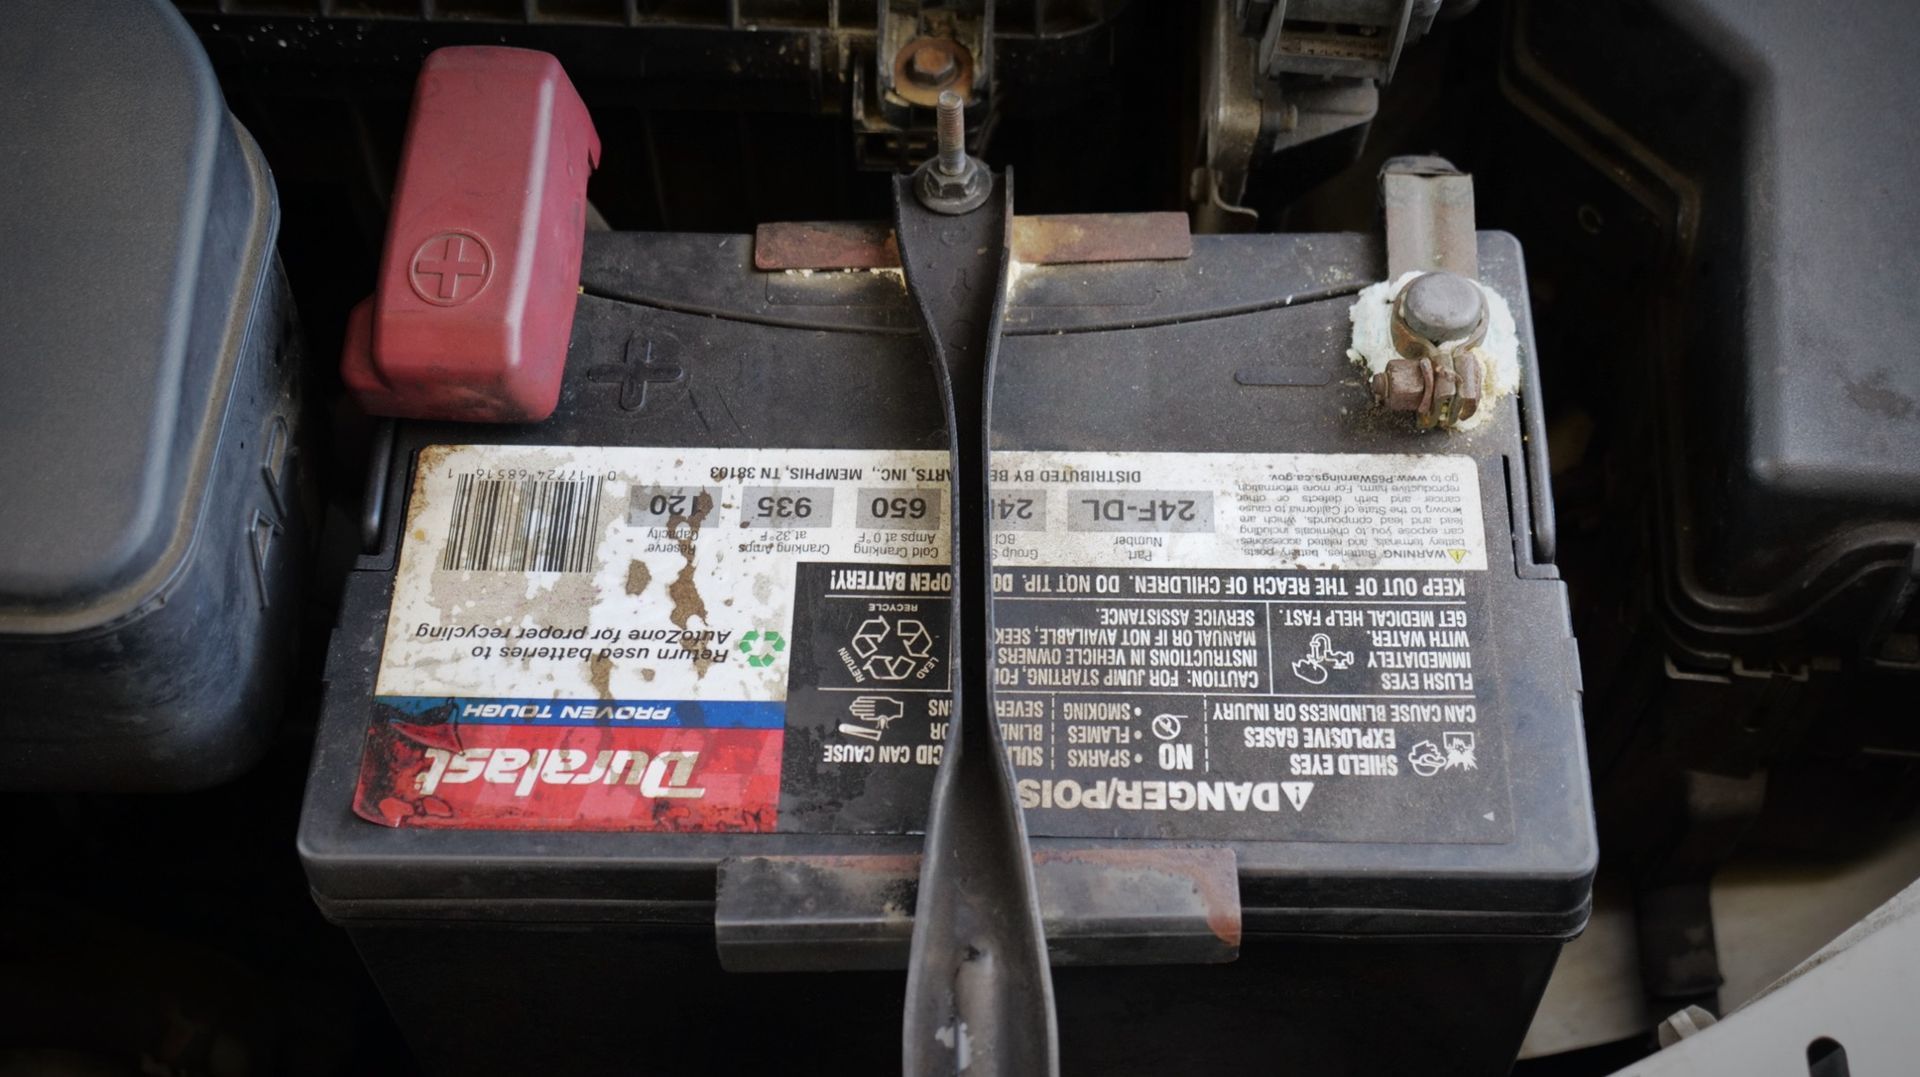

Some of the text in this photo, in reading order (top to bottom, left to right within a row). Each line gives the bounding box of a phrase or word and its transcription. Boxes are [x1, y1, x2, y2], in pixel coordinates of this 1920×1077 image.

[537, 470, 585, 482] 17724
[608, 470, 616, 481] 0
[710, 467, 756, 479] 38103
[760, 467, 780, 479] TN
[785, 465, 862, 480] MEMPHIS,
[872, 466, 907, 481] INC.,
[1014, 470, 1034, 482] BY
[1040, 470, 1141, 483] DISTRIBUTED
[1446, 474, 1459, 482] go
[1431, 475, 1443, 483] to
[1238, 484, 1460, 493] reproductive harm. For more information
[1237, 495, 1266, 504] other
[1302, 496, 1342, 504] defects
[1354, 496, 1379, 504] birth
[1391, 496, 1411, 504] and
[1424, 496, 1461, 504] cancer
[757, 496, 812, 517] 935
[871, 496, 927, 518] 650
[1081, 499, 1195, 522] 24F-DL
[1239, 504, 1271, 512] cause
[1275, 505, 1286, 514] to
[1289, 506, 1341, 515] California
[1344, 506, 1355, 515] of
[1358, 506, 1387, 515] State
[1389, 506, 1407, 515] the
[1410, 506, 1422, 514] to
[1239, 516, 1256, 524] are
[1264, 516, 1296, 525] which
[1380, 517, 1404, 526] lead
[1411, 517, 1432, 526] and
[1440, 517, 1463, 526] lead
[647, 528, 699, 541] Capacity
[795, 530, 807, 540] at
[1240, 524, 1289, 536] including
[1295, 527, 1349, 536] chemicals
[1355, 527, 1366, 536] to
[1371, 526, 1392, 536] you
[1398, 526, 1438, 535] expose
[884, 532, 897, 543] at
[901, 531, 936, 543] Amps
[995, 534, 1015, 545] BCI
[1114, 536, 1163, 547] Number
[1307, 538, 1342, 547] related
[1348, 538, 1367, 547] and
[1429, 537, 1465, 547] battery
[648, 544, 696, 555] Reserve
[738, 541, 830, 554] Cranking Amps
[854, 544, 939, 558] Cold Cranking
[1002, 547, 1038, 560] Group
[1240, 546, 1274, 557] posts,
[1128, 550, 1152, 562] Part
[830, 570, 1466, 596] KEEP OUT OF THE REACH OF CHILDREN. DO NOT TIP. DO OPEN BATTERY!
[868, 603, 918, 612] RECYCLE
[1095, 608, 1255, 626] SERVICE ASSISTANCE.
[1279, 609, 1467, 627] GET MEDICAL HELP FAST.
[416, 623, 732, 644] AutoZone for proper recycling
[995, 626, 1256, 646] MANUAL OR IF NOT AVAILABLE, SEEK
[1367, 630, 1470, 647] WITH WATER.
[471, 646, 729, 663] Return used batteries to
[998, 647, 1257, 667] INSTRUCTIONS IN VEHICLE OWNERS
[1367, 651, 1471, 668] IMMEDIATELY
[837, 646, 865, 683] RETURN
[916, 656, 939, 679] LEAD
[1022, 665, 1100, 686] STARTING,
[1105, 669, 1146, 686] JUMP
[1149, 670, 1179, 688] FOR
[1187, 670, 1259, 688] CAUTION:
[1381, 672, 1473, 690] FLUSH EYES
[463, 703, 671, 720] PROVEN TOUGH
[995, 700, 1044, 717] SEVER
[1063, 702, 1131, 720] SMOKING
[1213, 703, 1477, 723] CAN CAUSE BLINDNESS OR INJURY
[1067, 725, 1131, 743] FLAMES
[1243, 727, 1396, 749] EXPLOSIVE GASES
[823, 744, 874, 762] CAUSE
[879, 745, 910, 763] CAN
[916, 745, 944, 765] CID
[1067, 749, 1131, 768] SPARKS
[1158, 744, 1193, 770] NO
[1289, 754, 1398, 776] SHIELD EYES
[417, 748, 705, 798] Duralast
[1015, 778, 1280, 811] DANGER/POIS
